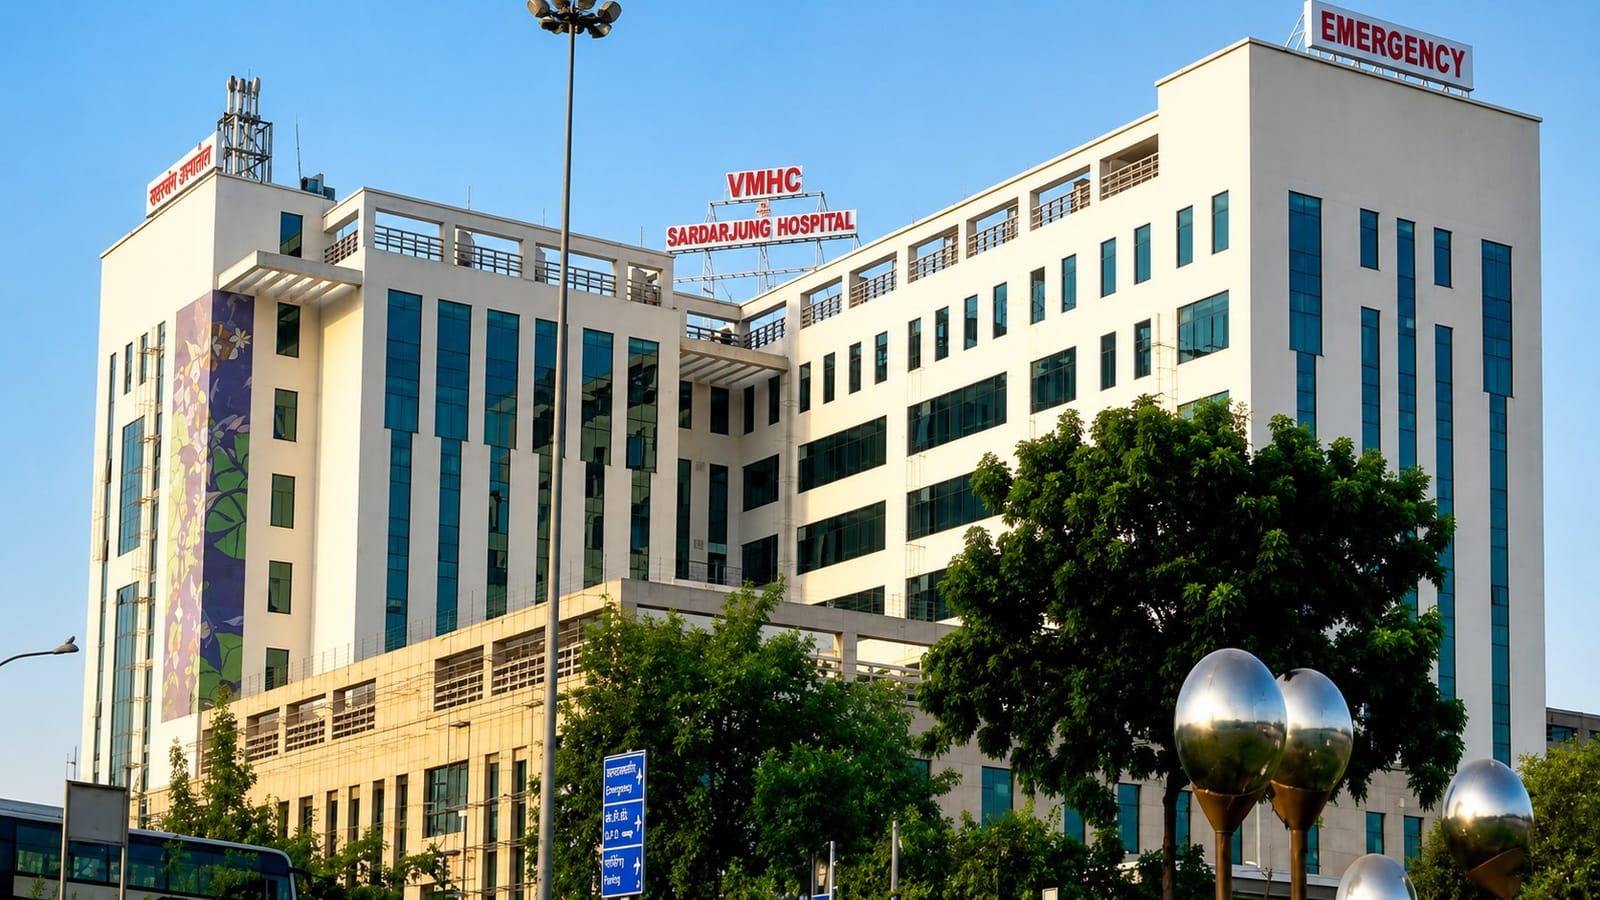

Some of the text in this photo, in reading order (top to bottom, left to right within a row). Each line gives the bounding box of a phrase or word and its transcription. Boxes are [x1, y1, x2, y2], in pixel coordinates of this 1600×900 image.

[1321, 10, 1465, 78] EMERGENCY
[727, 166, 802, 198] VMHC
[667, 211, 855, 247] SARDARJUNG HOSPITAL
